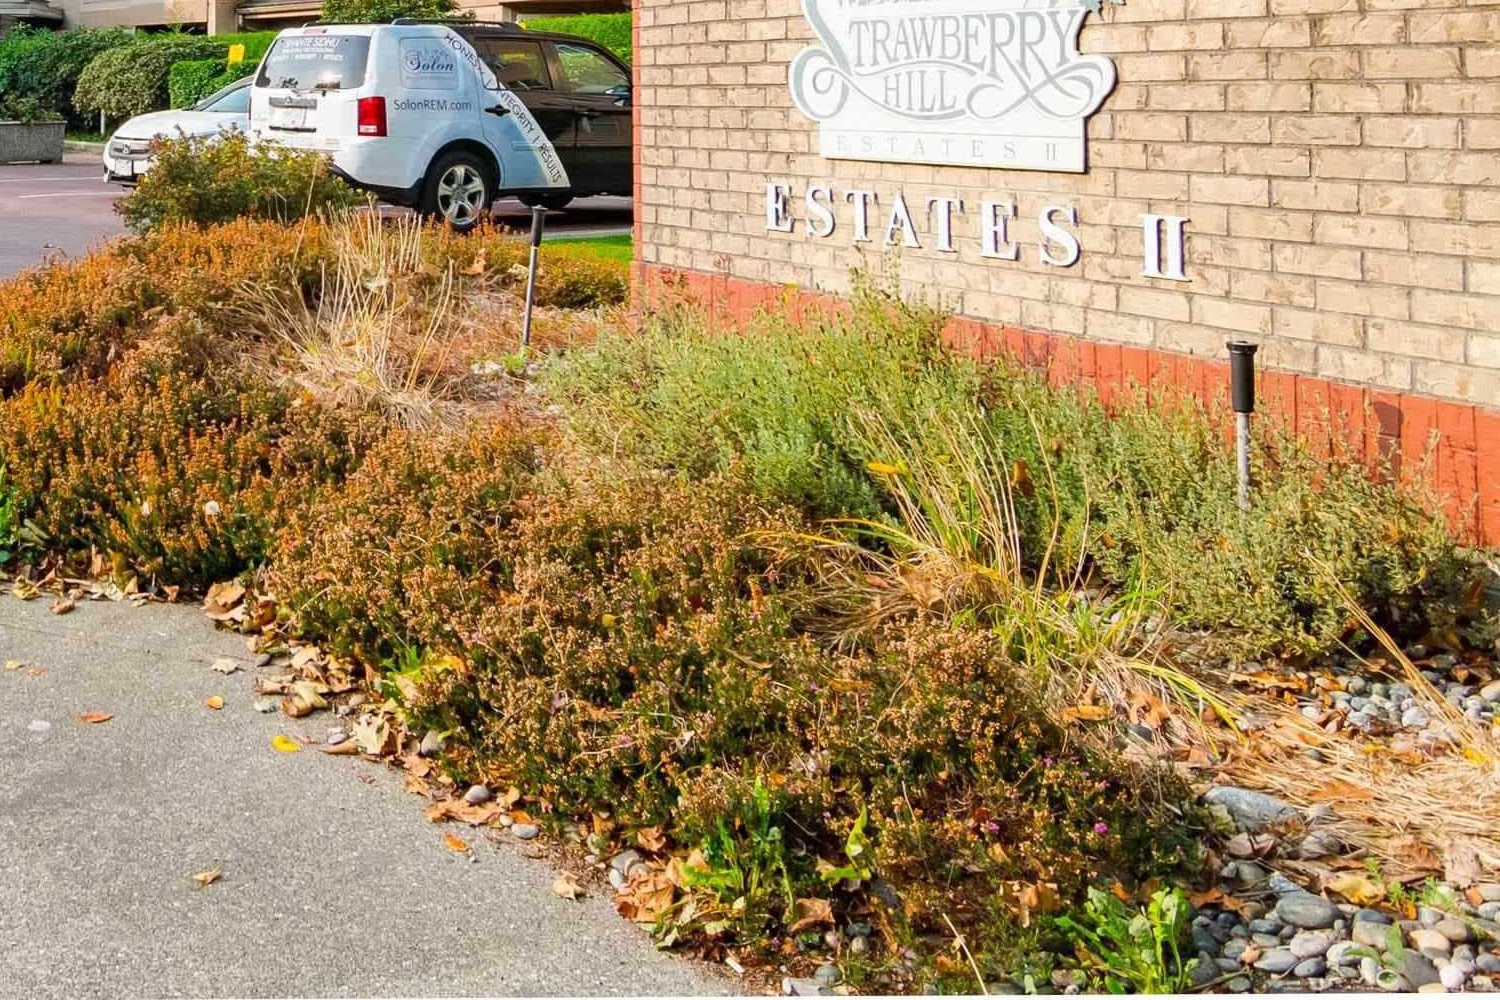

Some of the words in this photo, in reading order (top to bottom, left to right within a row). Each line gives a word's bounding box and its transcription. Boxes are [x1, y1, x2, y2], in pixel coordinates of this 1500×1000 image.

[393, 99, 472, 112] SolonREM.com
[883, 70, 957, 113] HILL
[539, 144, 563, 184] RESULTS
[836, 134, 1017, 159] ESTATES
[1045, 142, 1060, 162] II
[764, 182, 1082, 268] ESTATES
[1140, 213, 1192, 283] II
